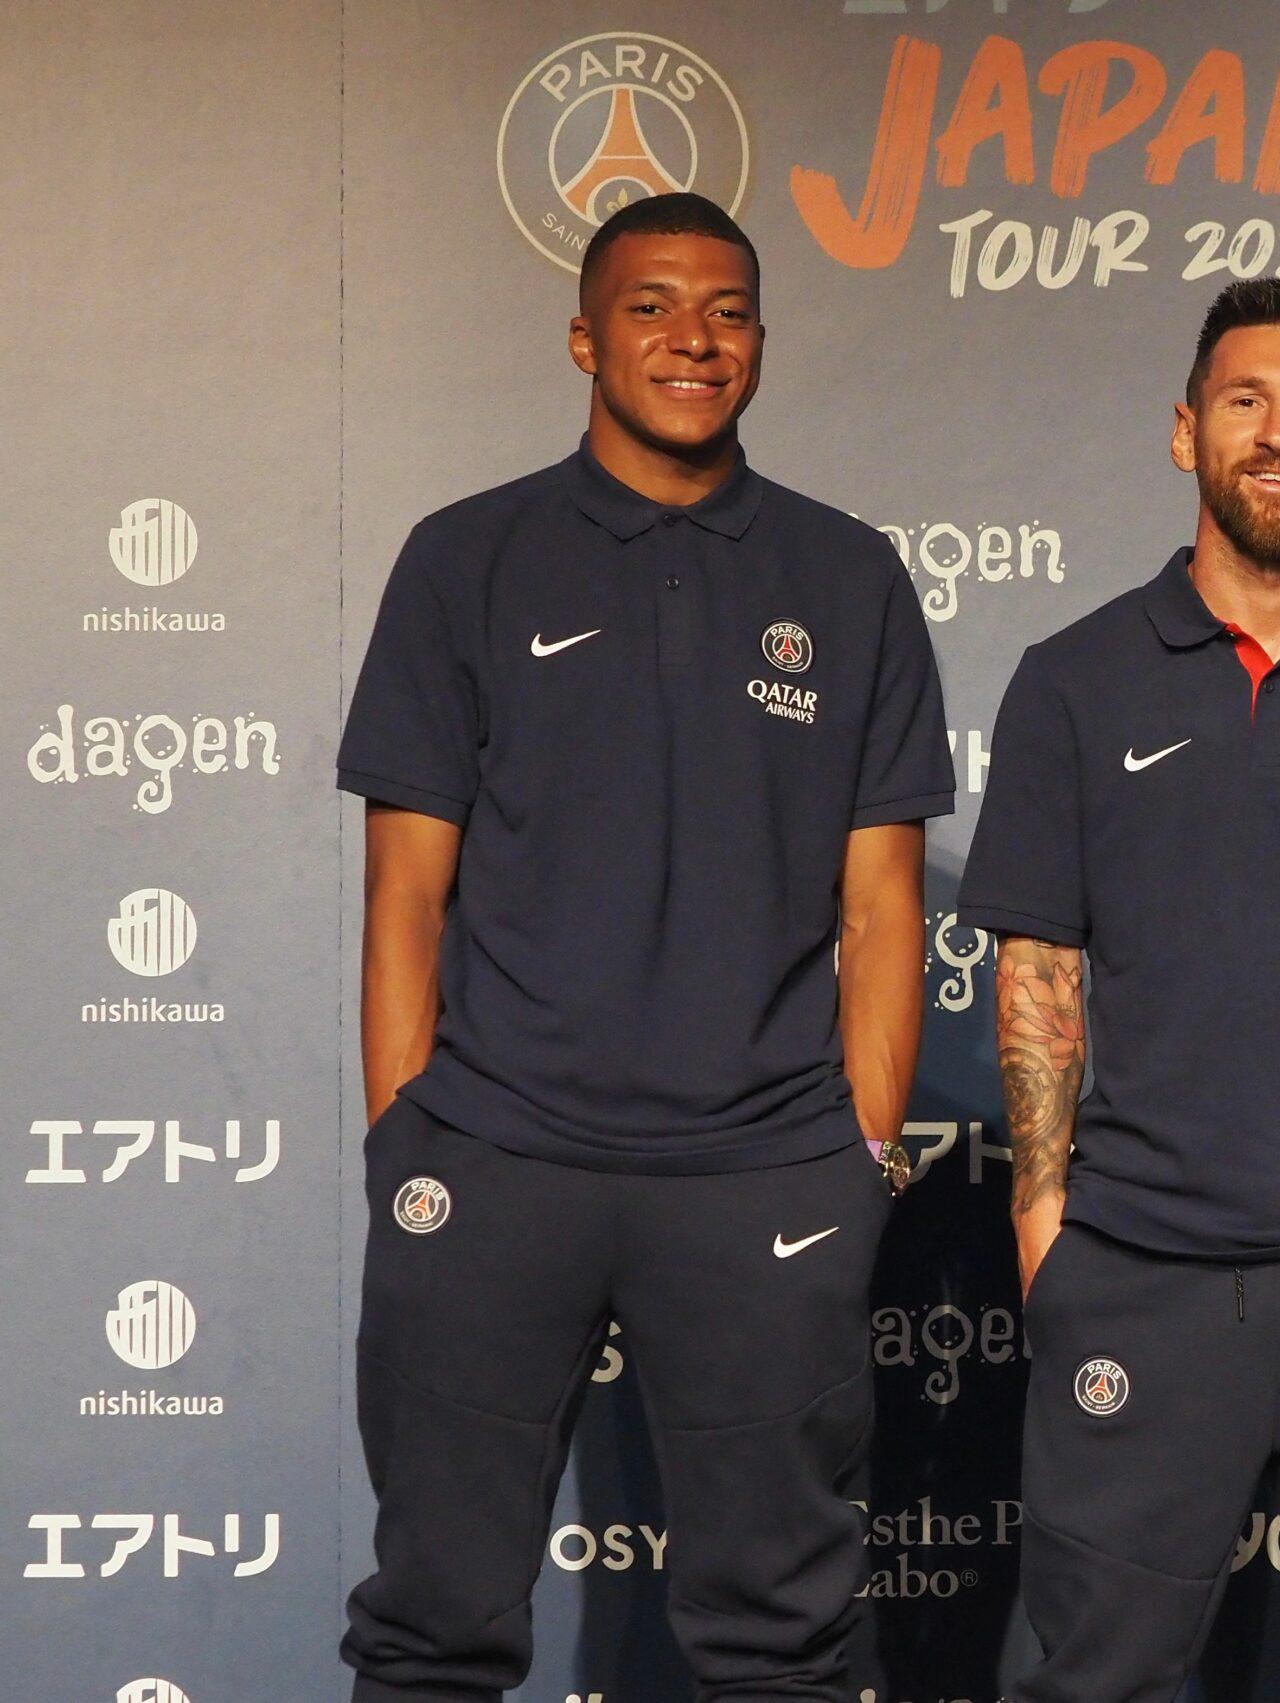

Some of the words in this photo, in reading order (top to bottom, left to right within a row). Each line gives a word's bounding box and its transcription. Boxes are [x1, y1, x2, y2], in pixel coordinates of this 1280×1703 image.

[539, 44, 704, 103] PARIS
[541, 212, 593, 251] SAIN
[939, 209, 1150, 298] TOUR
[848, 513, 1064, 622] gen
[83, 606, 226, 632] nishikawa
[770, 625, 804, 641] PARIS
[747, 679, 818, 712] QATAR
[765, 701, 815, 724] AIRWAYS
[27, 704, 282, 815] dagen
[81, 997, 226, 1023] nishikawa
[25, 1119, 281, 1184] エアトリ
[872, 1304, 1033, 1405] age
[1087, 1362, 1121, 1380] PARIS
[80, 1389, 224, 1416] nishikawa
[849, 1496, 982, 1546] sthe
[23, 1513, 280, 1578] エアトリ
